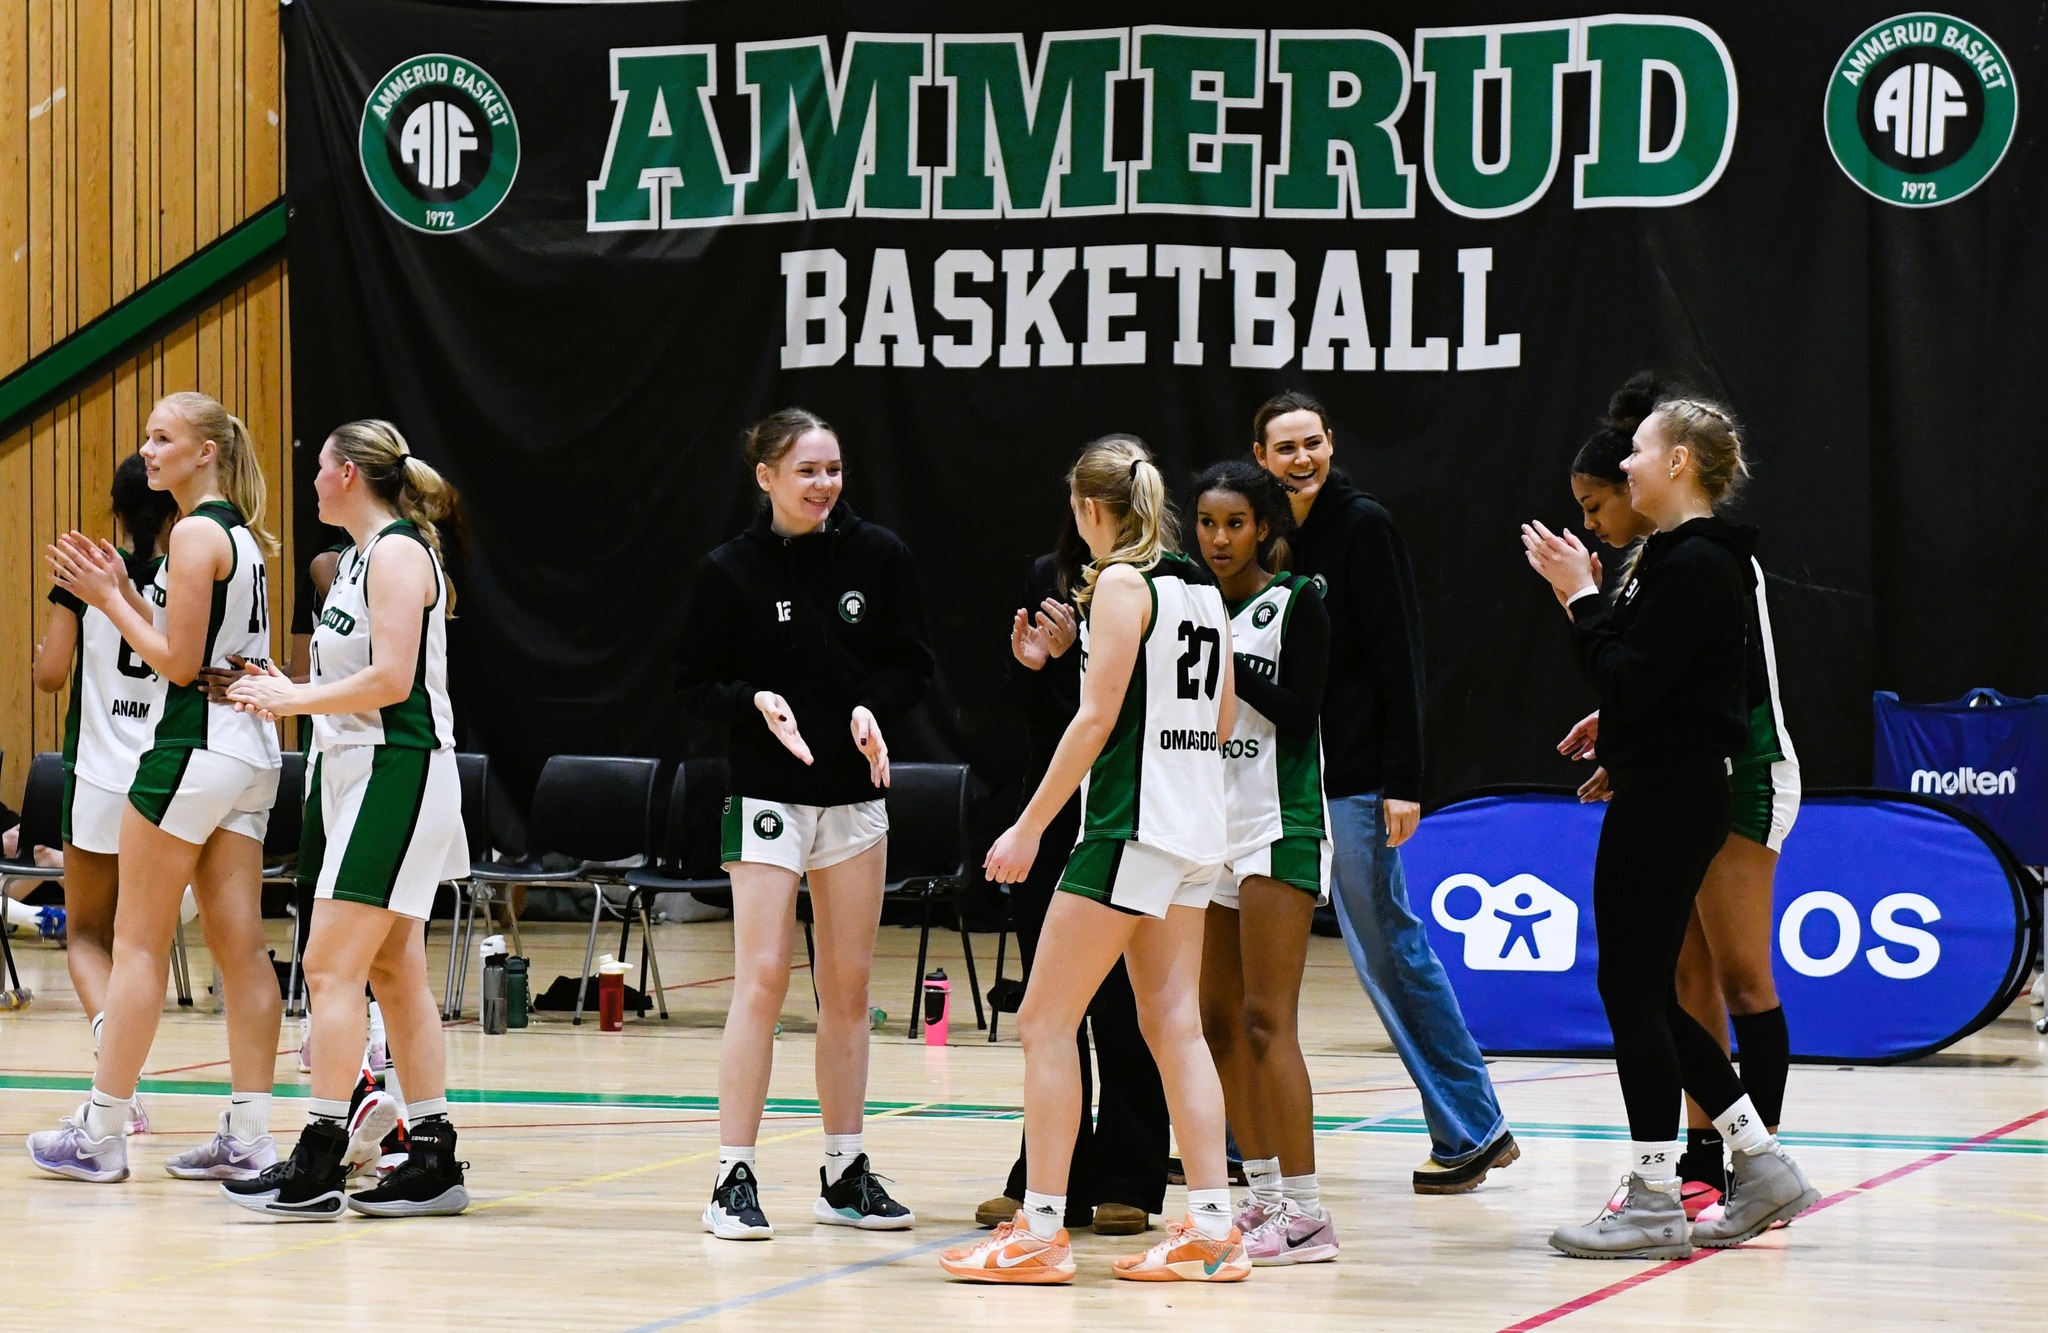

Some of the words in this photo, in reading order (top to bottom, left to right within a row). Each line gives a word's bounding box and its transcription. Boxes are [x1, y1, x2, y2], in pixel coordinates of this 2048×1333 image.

[1841, 21, 1937, 87] AMMERUD
[1941, 25, 2007, 90] BASKET
[371, 62, 448, 121] AMMERUD
[452, 66, 510, 127] BASKET
[587, 13, 1738, 233] AMMERUD
[1873, 62, 1968, 159] AIF
[400, 100, 479, 189] AIF
[425, 209, 456, 228] 1972
[1901, 181, 1938, 201] 1972
[780, 243, 1521, 372] BASKETBALL
[1219, 738, 1259, 760] BOS
[1910, 766, 2016, 796] molten
[1779, 890, 1942, 980] OS
[1727, 1114, 1749, 1136] 23
[1641, 1152, 1666, 1165] 23
